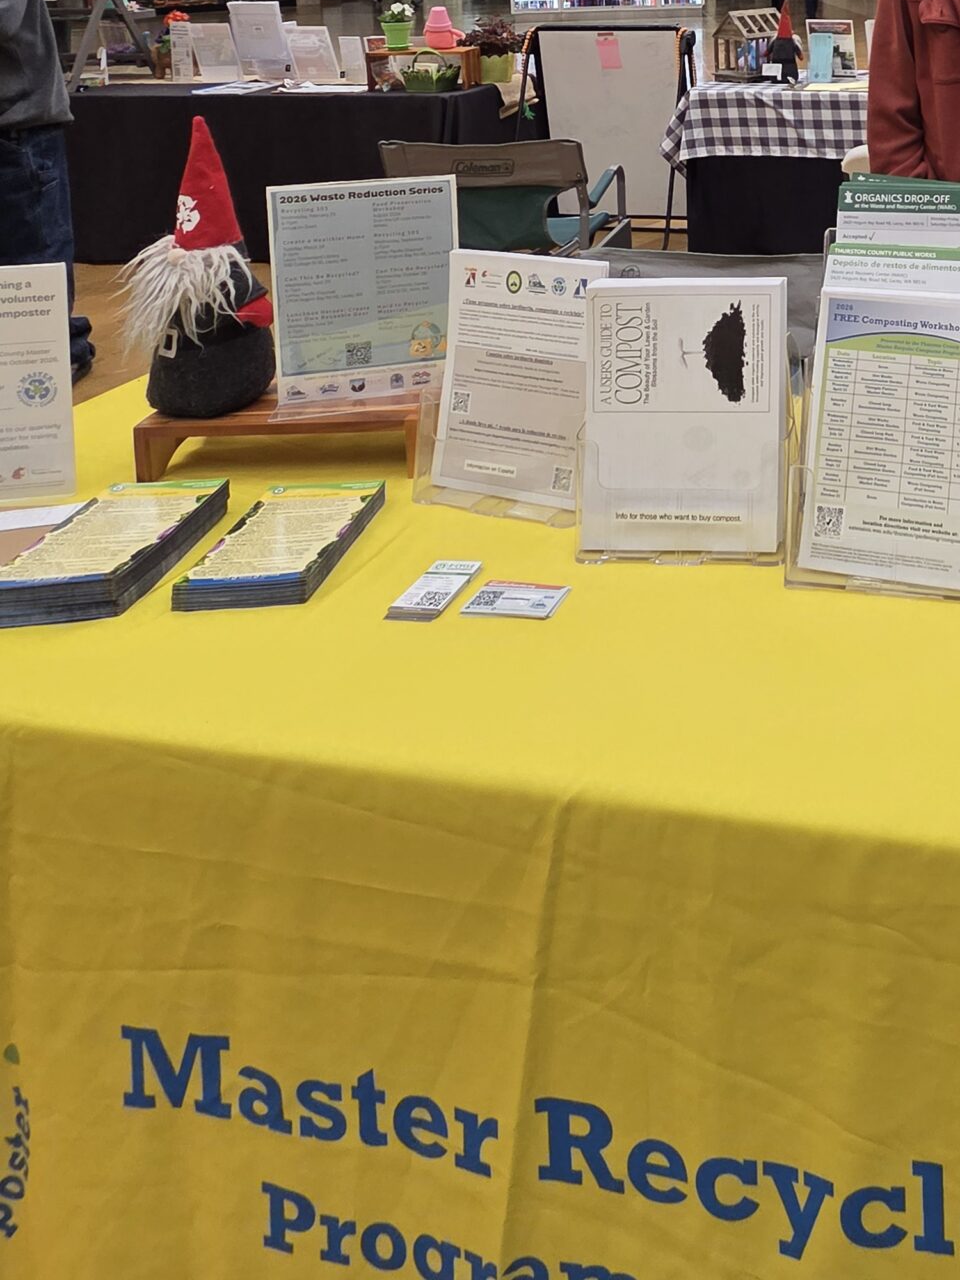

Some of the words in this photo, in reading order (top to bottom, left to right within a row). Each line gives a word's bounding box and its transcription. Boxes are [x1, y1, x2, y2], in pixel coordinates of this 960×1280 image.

[456, 162, 501, 173] Coleman
[280, 195, 308, 204] 2026
[310, 193, 345, 202] Waste
[348, 189, 406, 200] Reduction
[409, 187, 444, 195] Series
[855, 193, 902, 203] ORGANICS
[904, 194, 950, 204] DROP-OFF
[870, 260, 881, 268] de
[921, 263, 960, 272] alimentos
[1, 294, 56, 304] volunteer
[600, 303, 612, 321] TO
[833, 313, 860, 324] FREE
[862, 316, 918, 330] Composting
[600, 322, 612, 358] GUIDE
[614, 303, 643, 405] COMPOST
[644, 363, 650, 371] of
[643, 372, 651, 392] Beauty
[600, 397, 612, 405] A
[615, 512, 628, 520] Info
[699, 514, 711, 522] buy
[902, 517, 932, 527] information
[120, 1024, 499, 1178] Master
